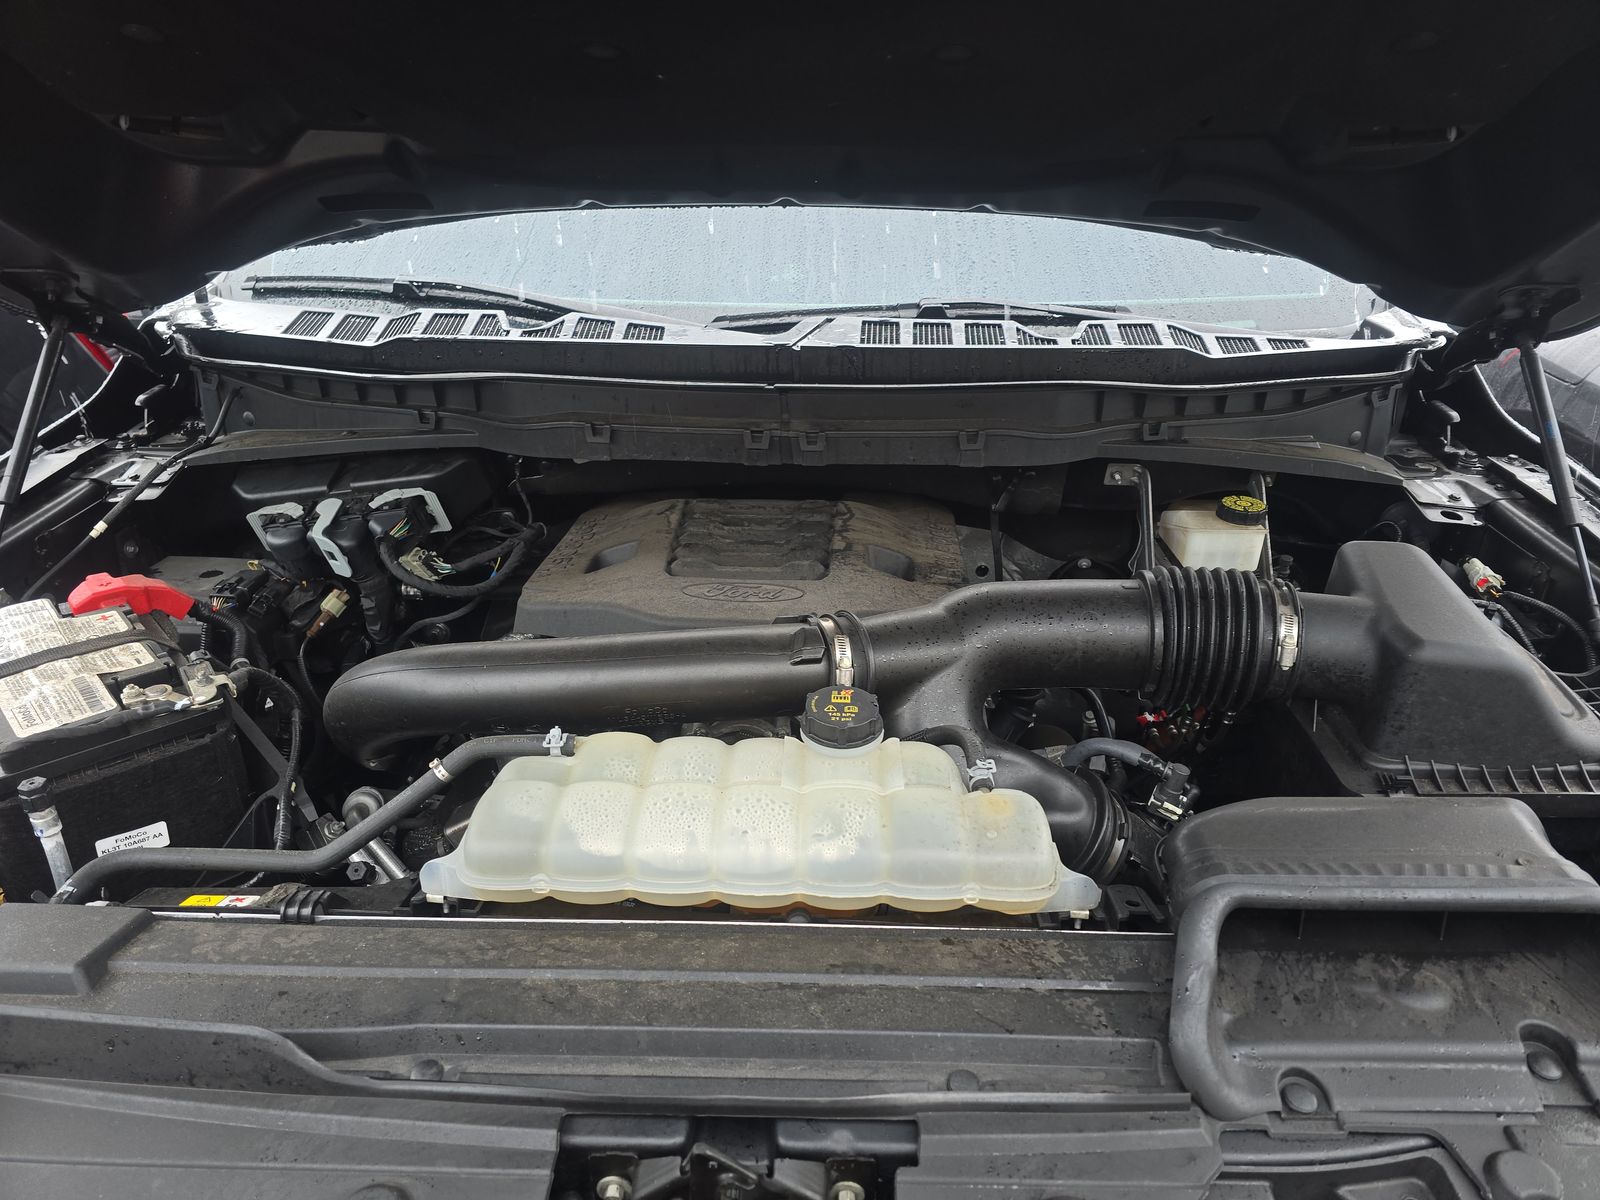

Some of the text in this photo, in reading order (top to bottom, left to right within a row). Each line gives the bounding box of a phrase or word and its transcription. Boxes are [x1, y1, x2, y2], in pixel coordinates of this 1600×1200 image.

[702, 584, 785, 600] Ford
[101, 832, 163, 855] KL3T 10A687 AA
[115, 831, 147, 844] FoMoCo
